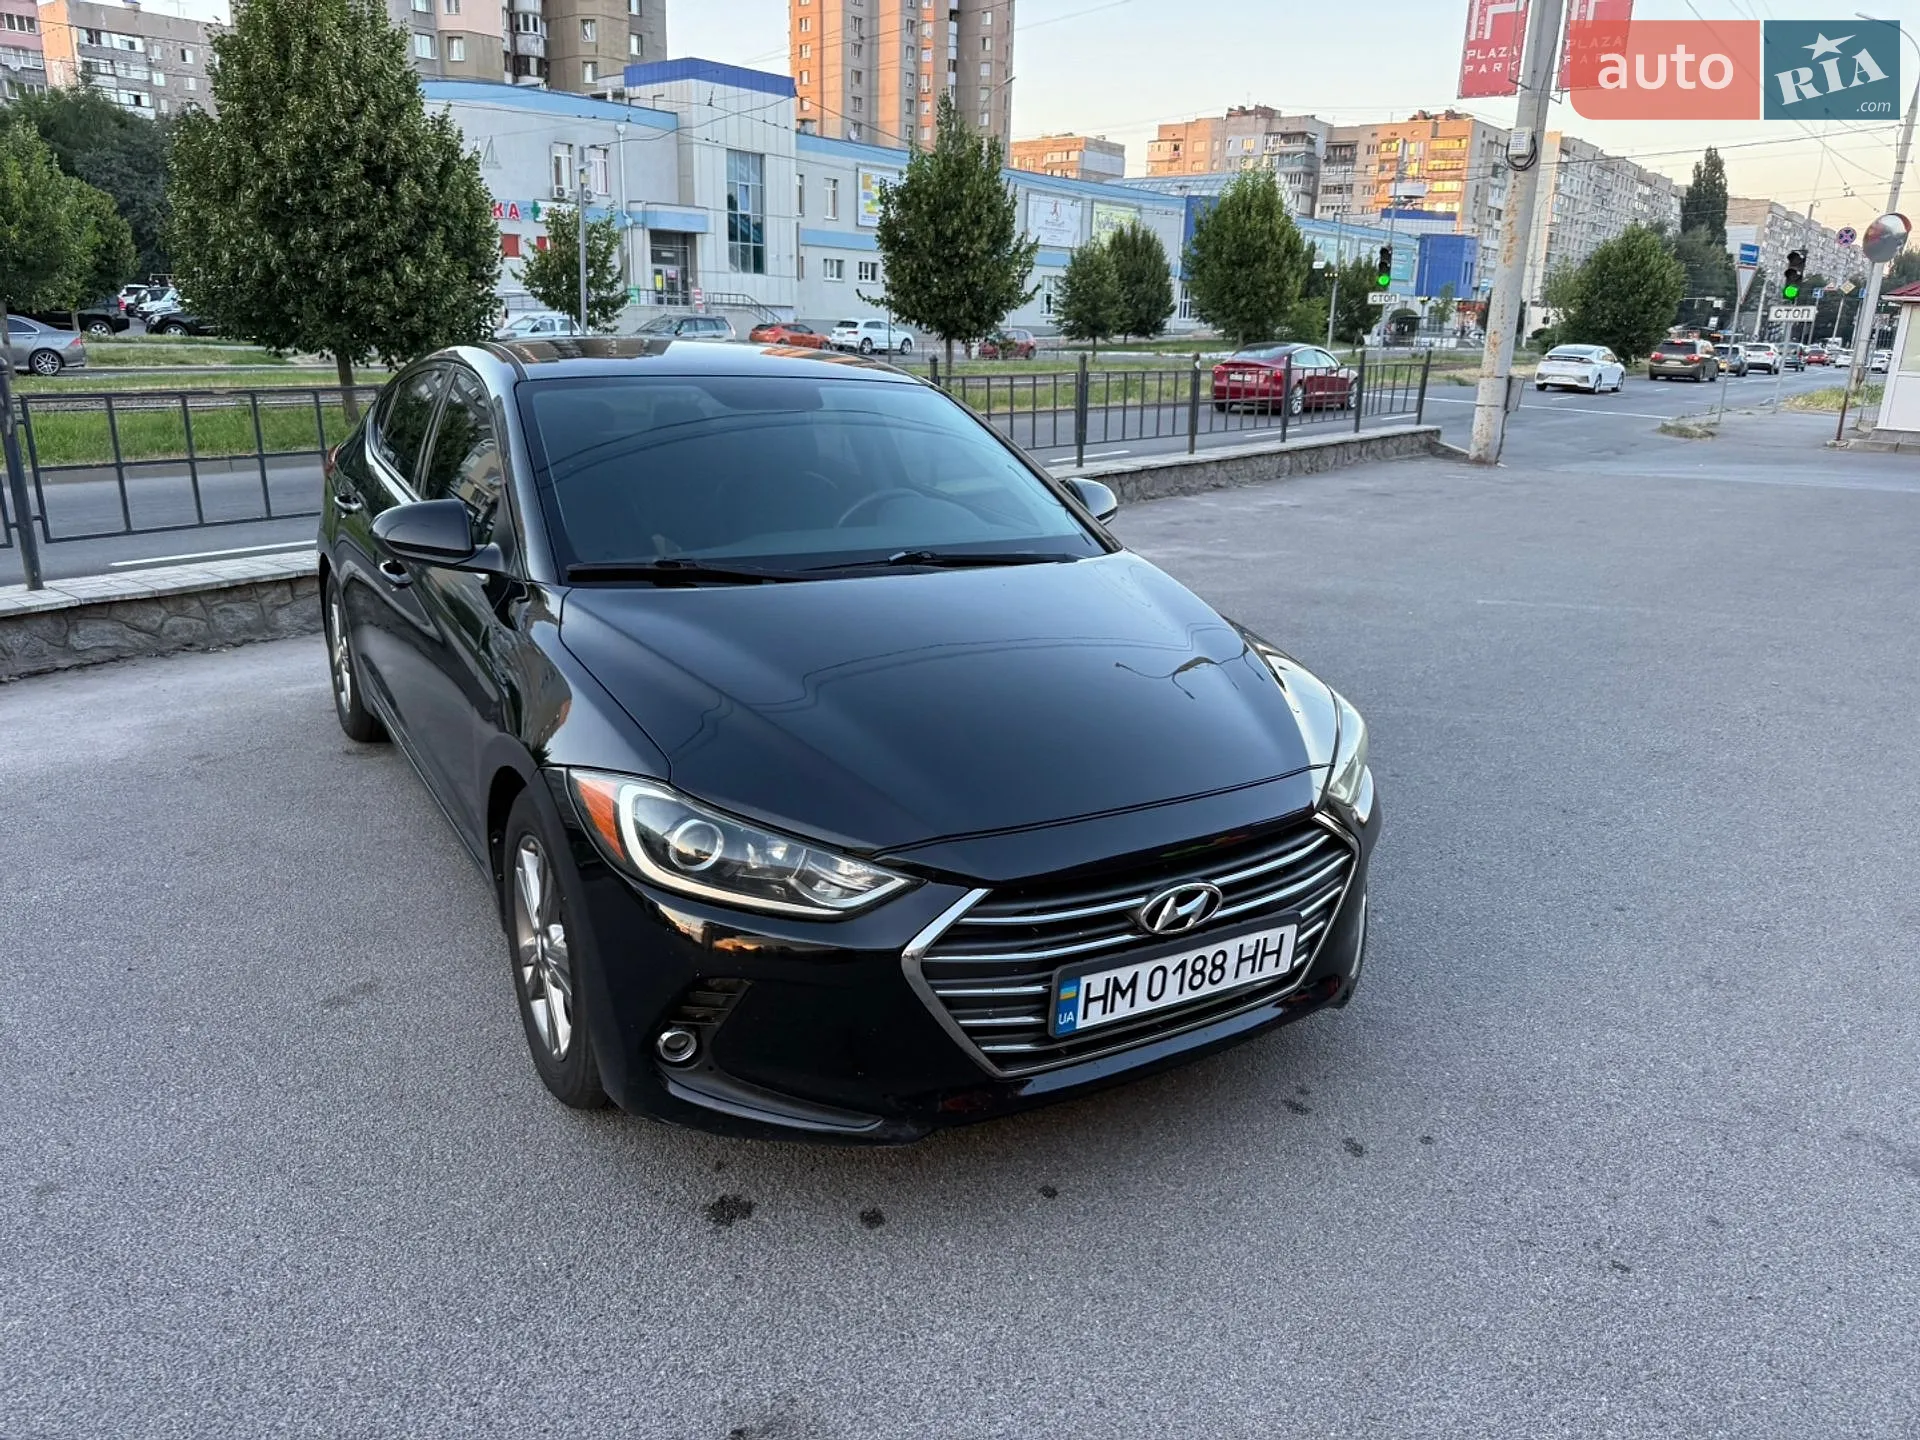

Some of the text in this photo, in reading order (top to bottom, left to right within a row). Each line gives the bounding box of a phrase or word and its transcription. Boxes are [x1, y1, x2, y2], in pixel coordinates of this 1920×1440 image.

[1466, 46, 1519, 60] PLAZA
[1463, 60, 1519, 75] PARK
[1371, 294, 1398, 303] СТОП
[1774, 308, 1811, 319] СТОП
[1082, 933, 1285, 1020] HM 0188 HH
[1058, 1011, 1075, 1025] UA
